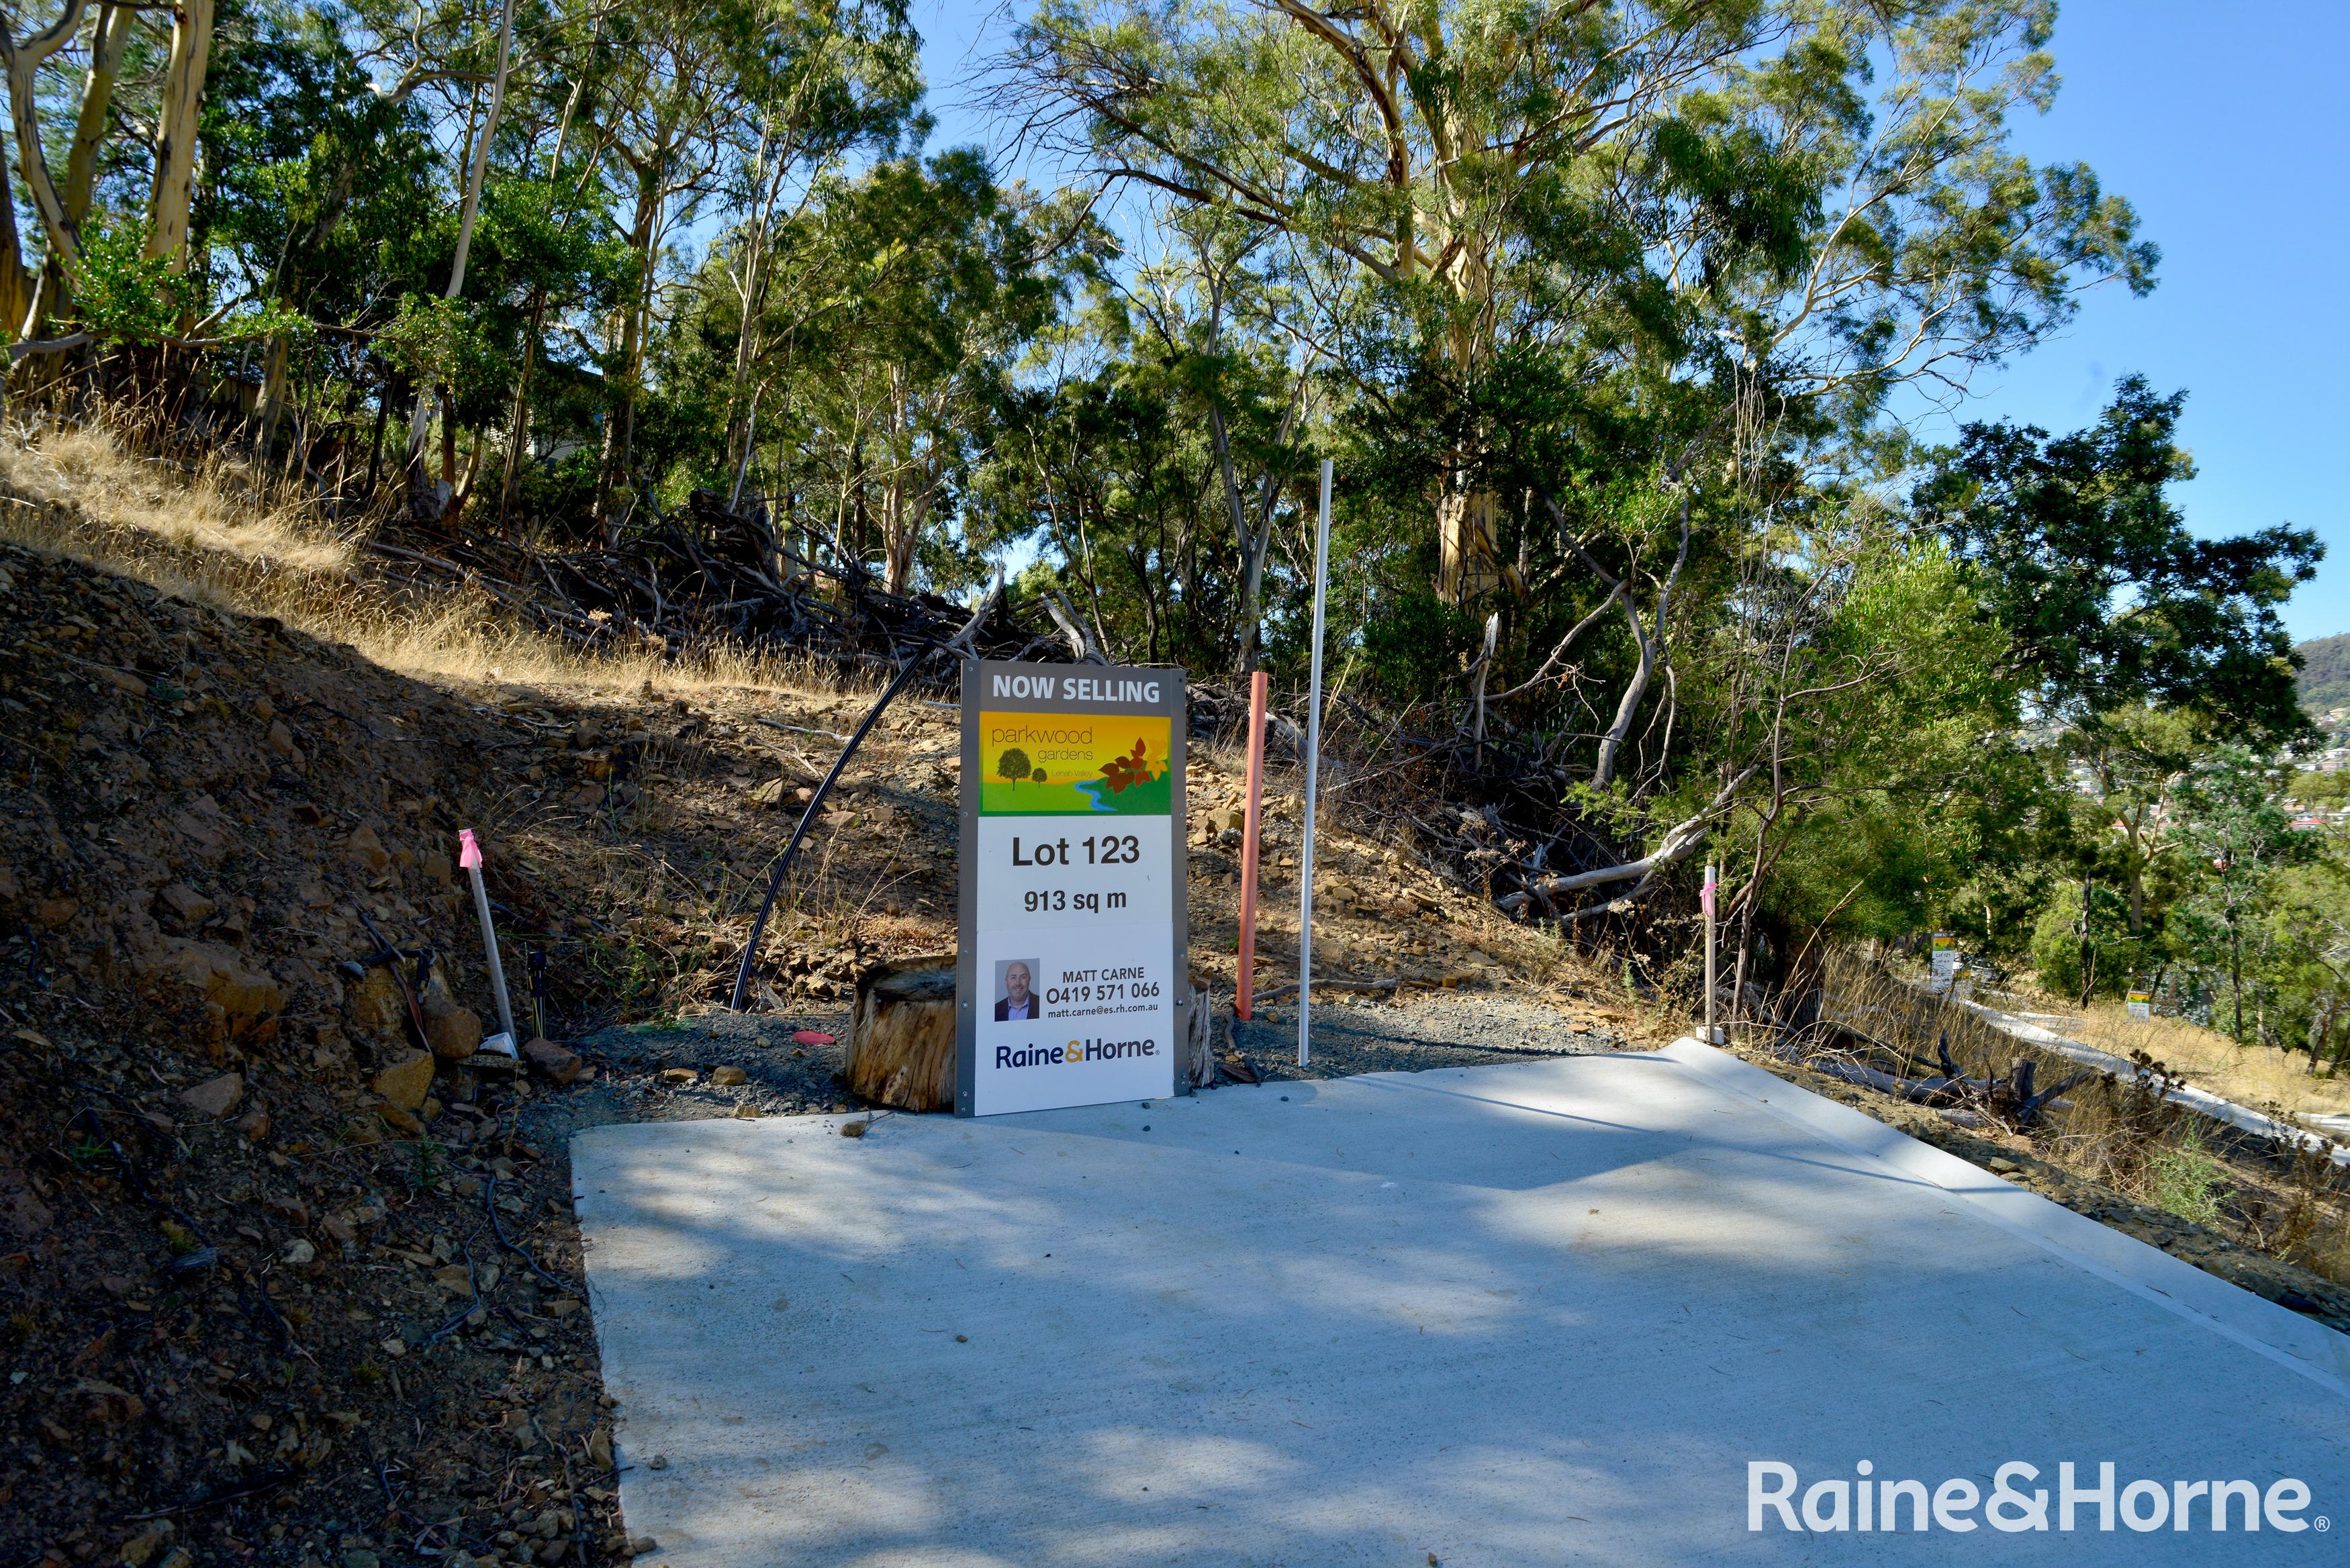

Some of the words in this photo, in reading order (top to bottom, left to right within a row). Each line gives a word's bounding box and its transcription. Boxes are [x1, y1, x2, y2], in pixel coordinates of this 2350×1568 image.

[993, 675, 1055, 699] NOW
[1063, 678, 1160, 703] SELLING
[992, 725, 1092, 747] parkwood
[1038, 748, 1093, 763] gardens
[1013, 837, 1069, 866] Lot
[1082, 835, 1140, 865] 123
[1024, 890, 1066, 912] 913
[1073, 893, 1098, 914] sq
[1107, 891, 1127, 908] m
[1063, 970, 1098, 983] MATT
[1101, 967, 1145, 981] CARNE
[1096, 984, 1124, 1001] 571
[1131, 981, 1160, 999] 066
[1048, 1004, 1158, 1018] matt.carne@es.rh.com.au
